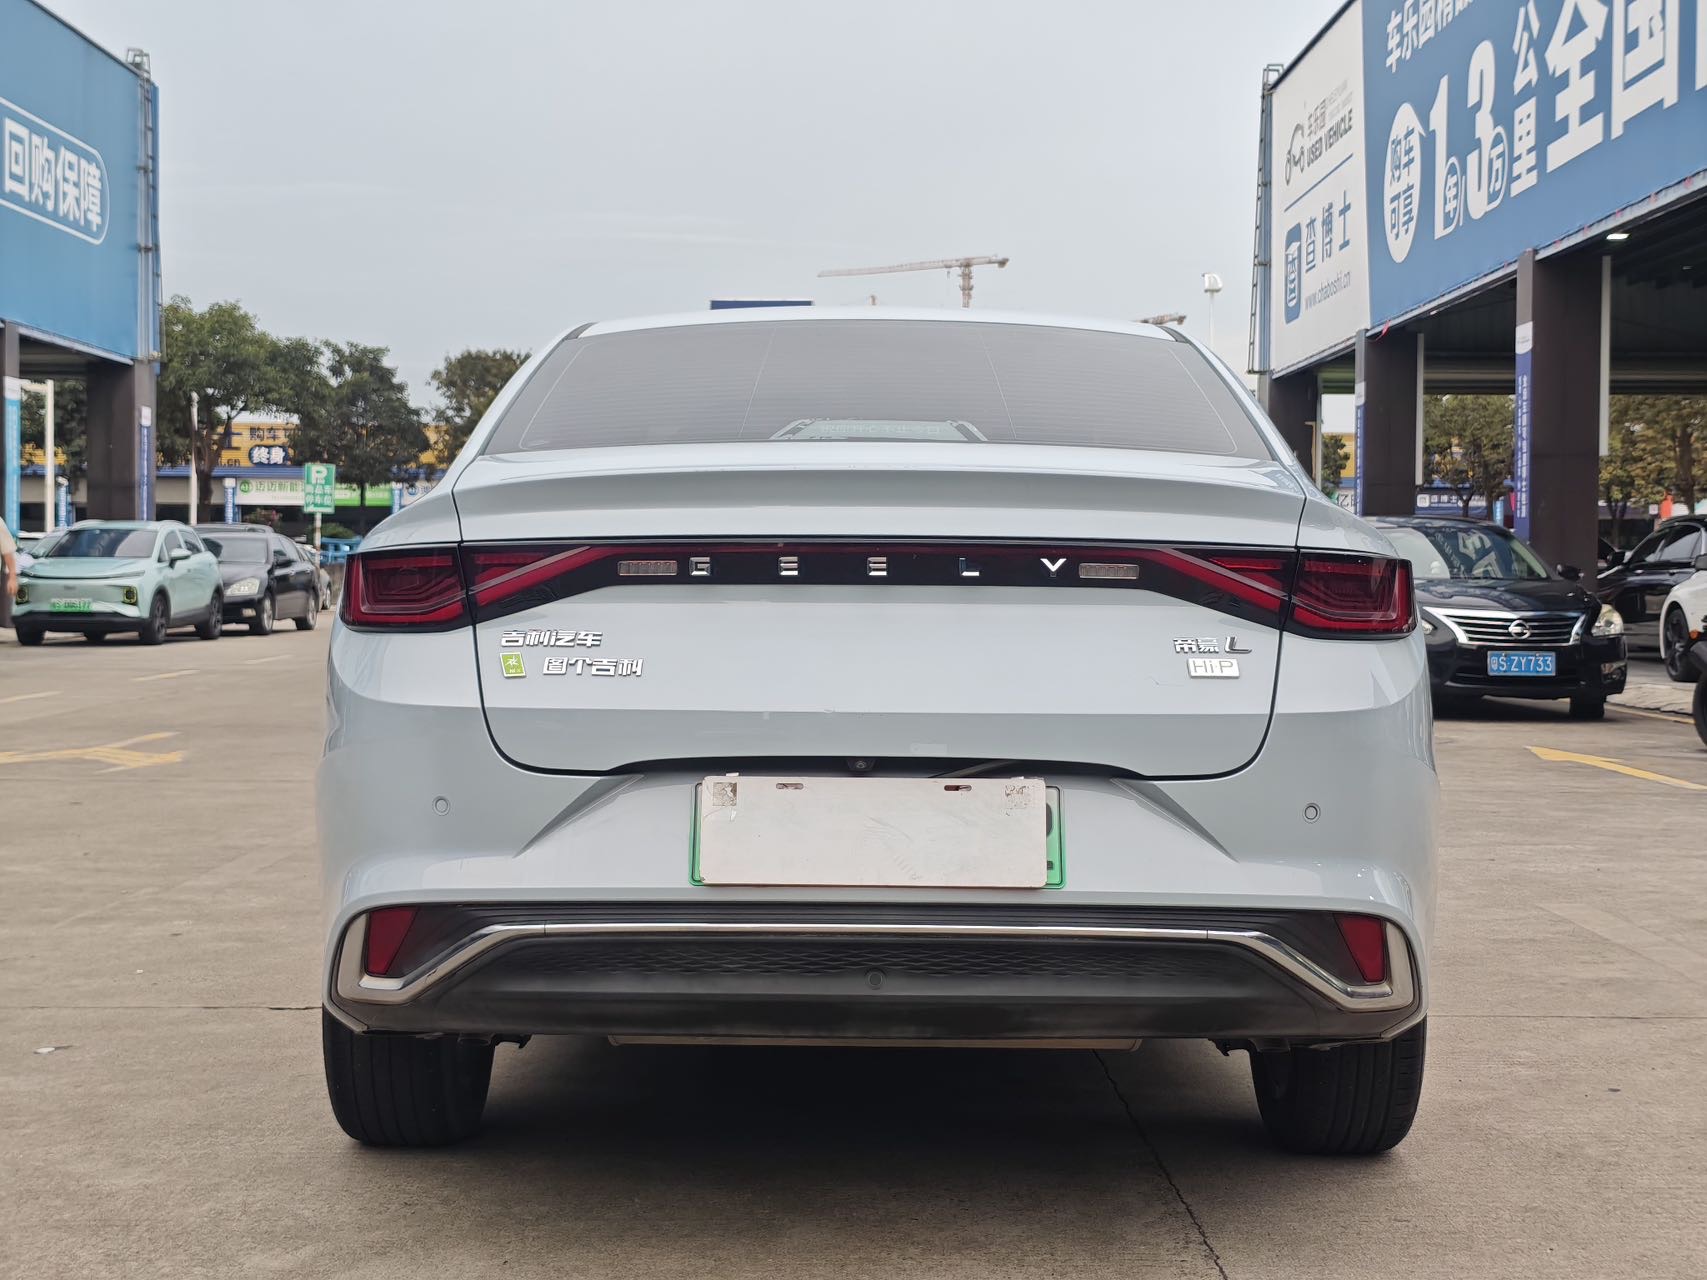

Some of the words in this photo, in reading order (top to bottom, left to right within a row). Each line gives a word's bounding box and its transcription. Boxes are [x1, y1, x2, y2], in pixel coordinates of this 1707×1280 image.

[1386, 0, 1474, 73] 车乐园
[1306, 136, 1323, 168] USED
[1324, 107, 1353, 152] VEHICLE
[4, 117, 102, 232] 回购保障
[1305, 189, 1352, 274] 查博士
[688, 556, 1067, 577] GEELY
[500, 629, 603, 648] 吉利汽车
[542, 656, 644, 677] 图个吉利
